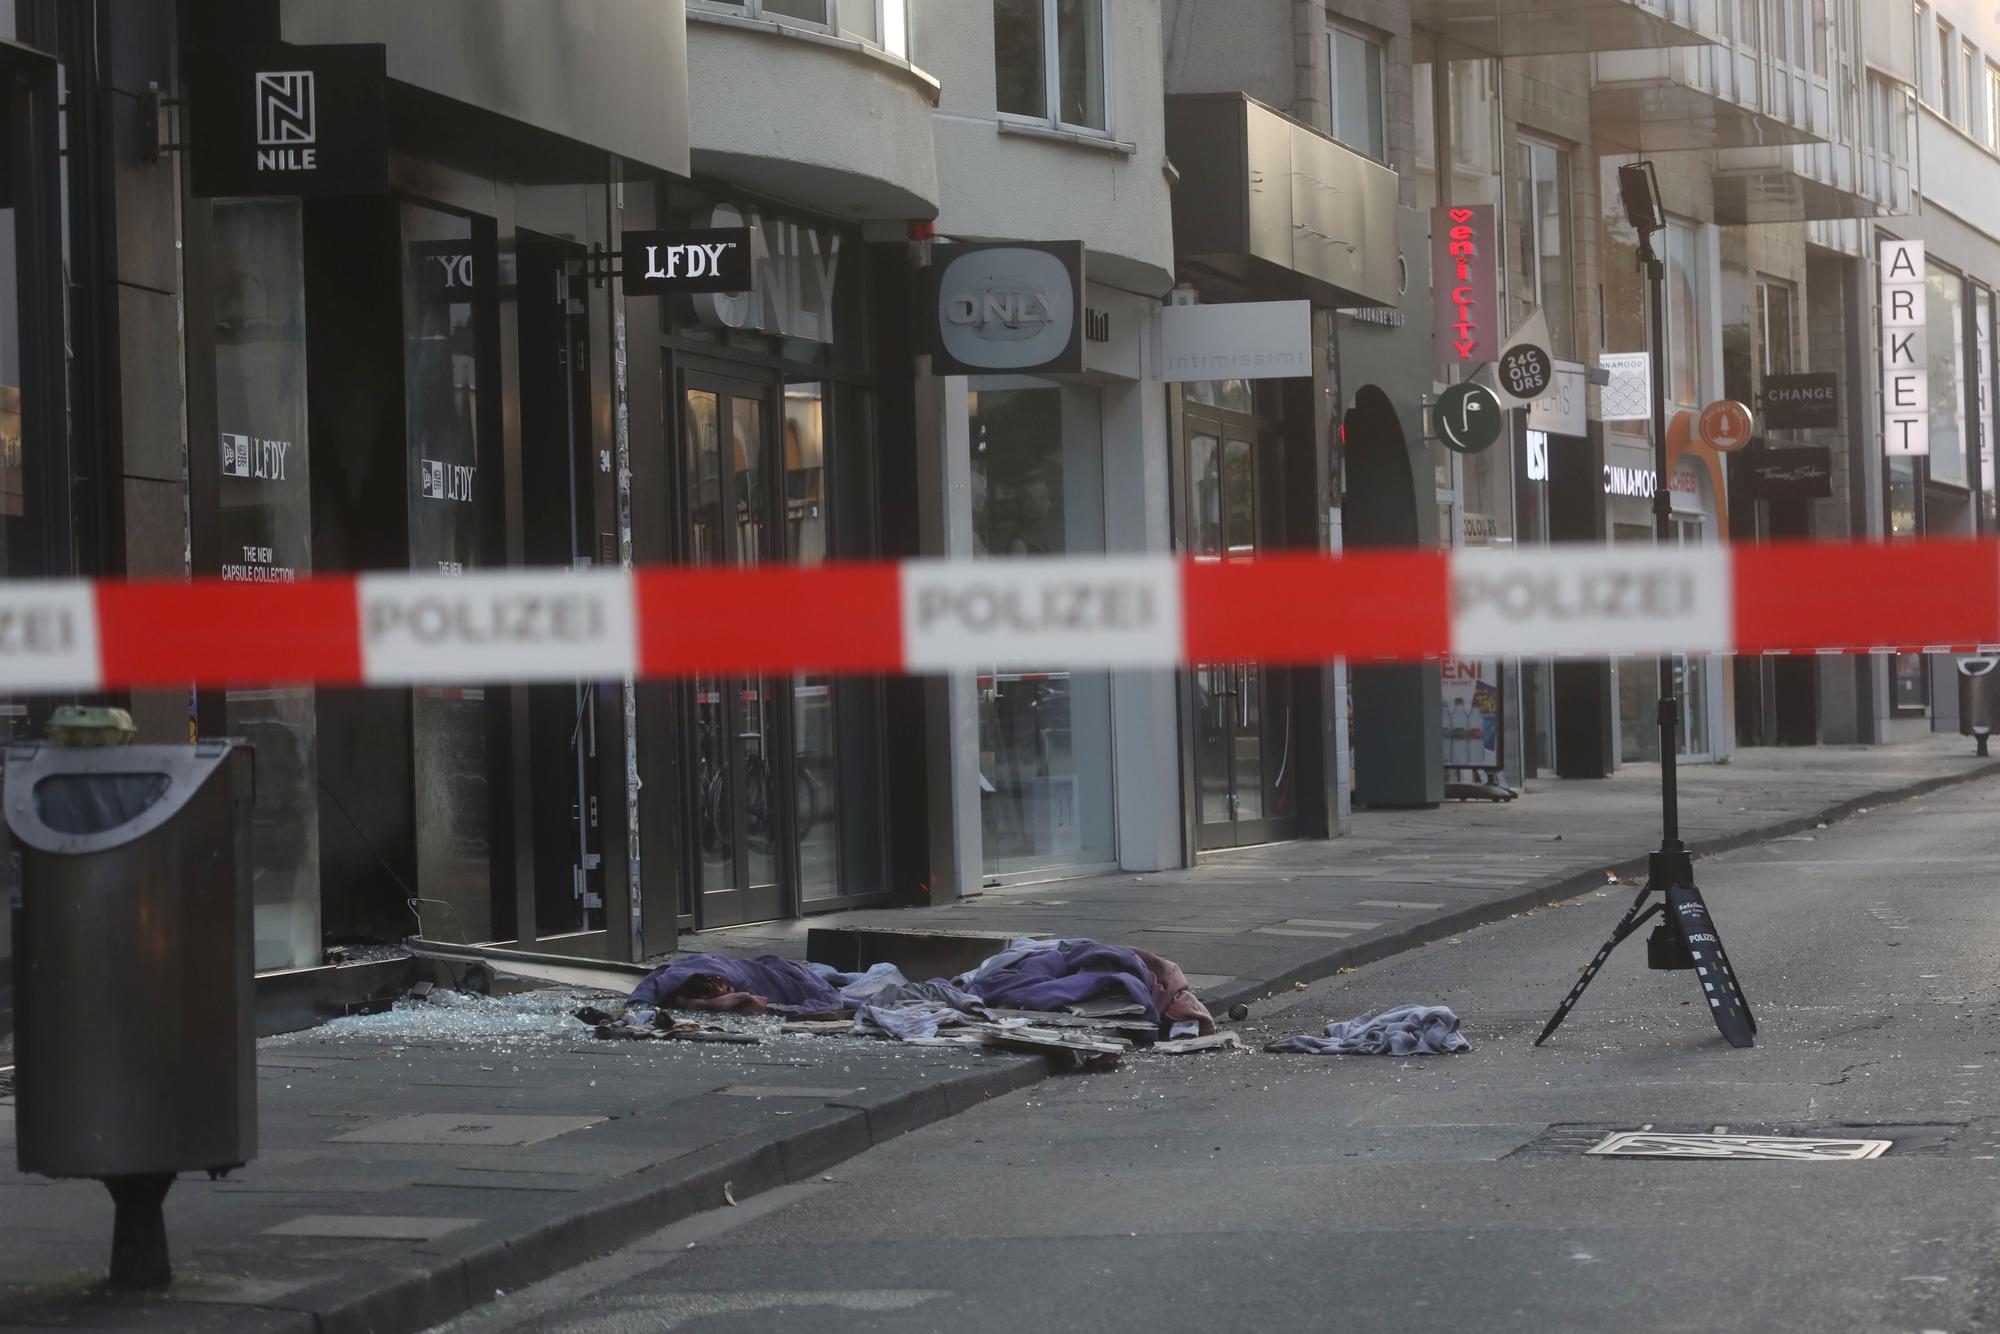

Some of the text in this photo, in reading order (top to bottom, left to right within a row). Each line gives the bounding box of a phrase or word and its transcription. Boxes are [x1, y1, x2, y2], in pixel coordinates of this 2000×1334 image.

[257, 149, 316, 171] NILE
[946, 289, 1060, 325] ONLY
[1889, 247, 1918, 450] ARKET
[1168, 351, 1304, 369] intimissimi
[1507, 350, 1537, 369] 24C
[1509, 362, 1540, 380] OLO
[1512, 374, 1543, 393] URS
[1768, 387, 1834, 401] CHANGE
[243, 546, 272, 563] THE NEW
[222, 564, 294, 584] CAPSULE COLLECTION
[1453, 568, 1696, 625] POLIZEI
[918, 580, 1156, 634] POLIZEI
[367, 595, 606, 646] POLIZEI
